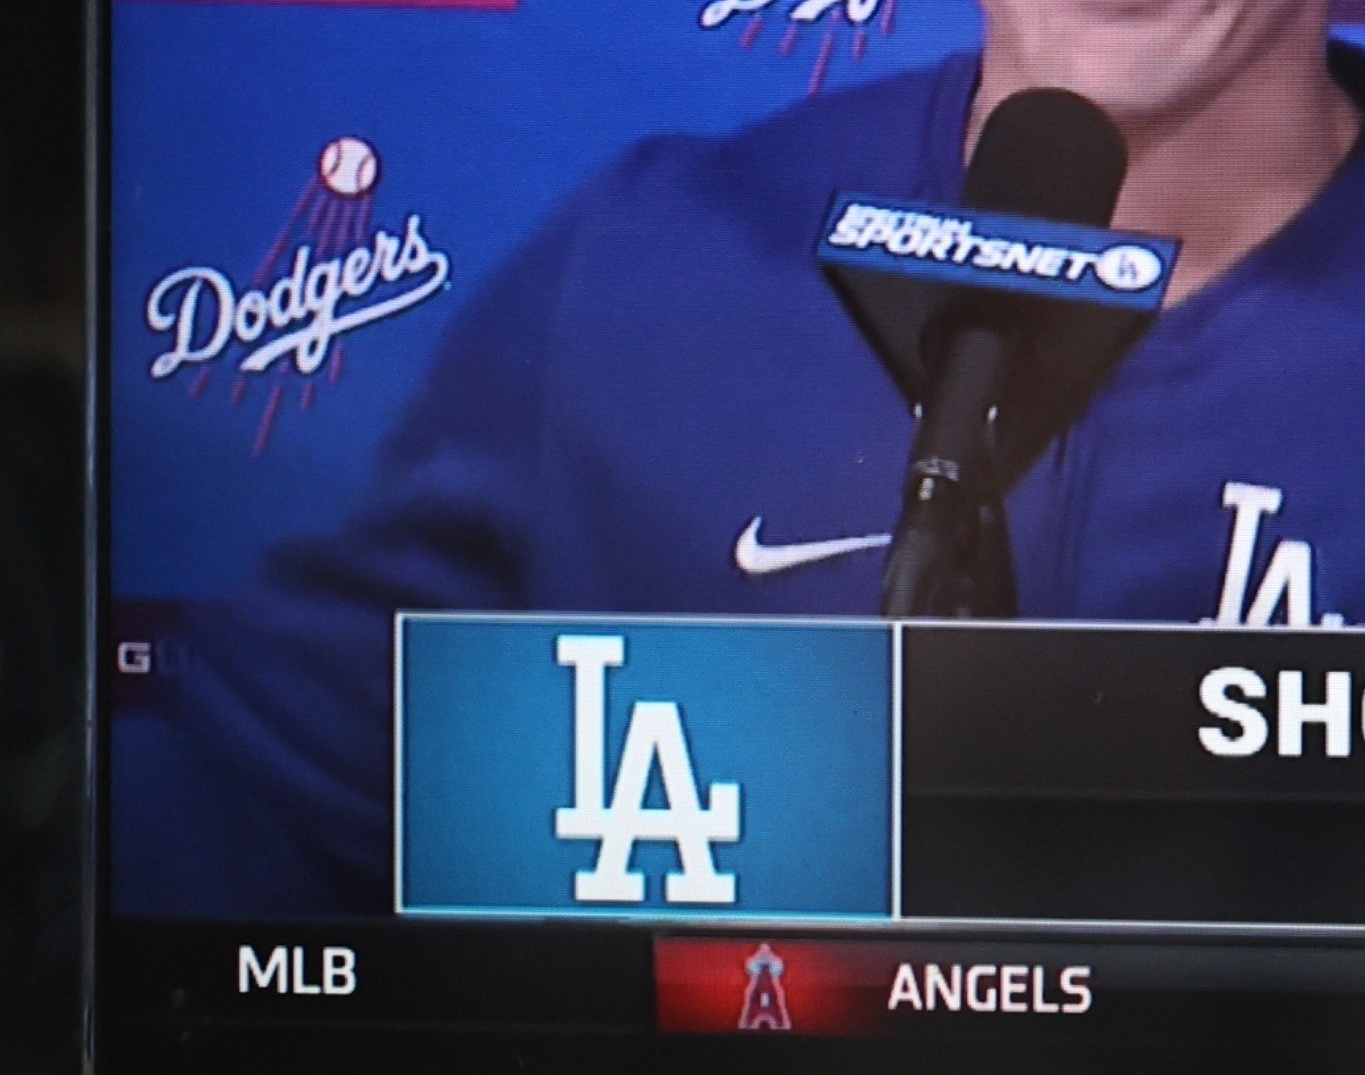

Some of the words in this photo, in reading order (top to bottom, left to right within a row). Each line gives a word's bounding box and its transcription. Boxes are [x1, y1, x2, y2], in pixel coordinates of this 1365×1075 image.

[827, 221, 1098, 281] SPORTSNET
[147, 214, 448, 376] Dodgers
[556, 634, 740, 903] LA
[239, 946, 356, 995] MLB
[888, 963, 1092, 1013] ANGELS
